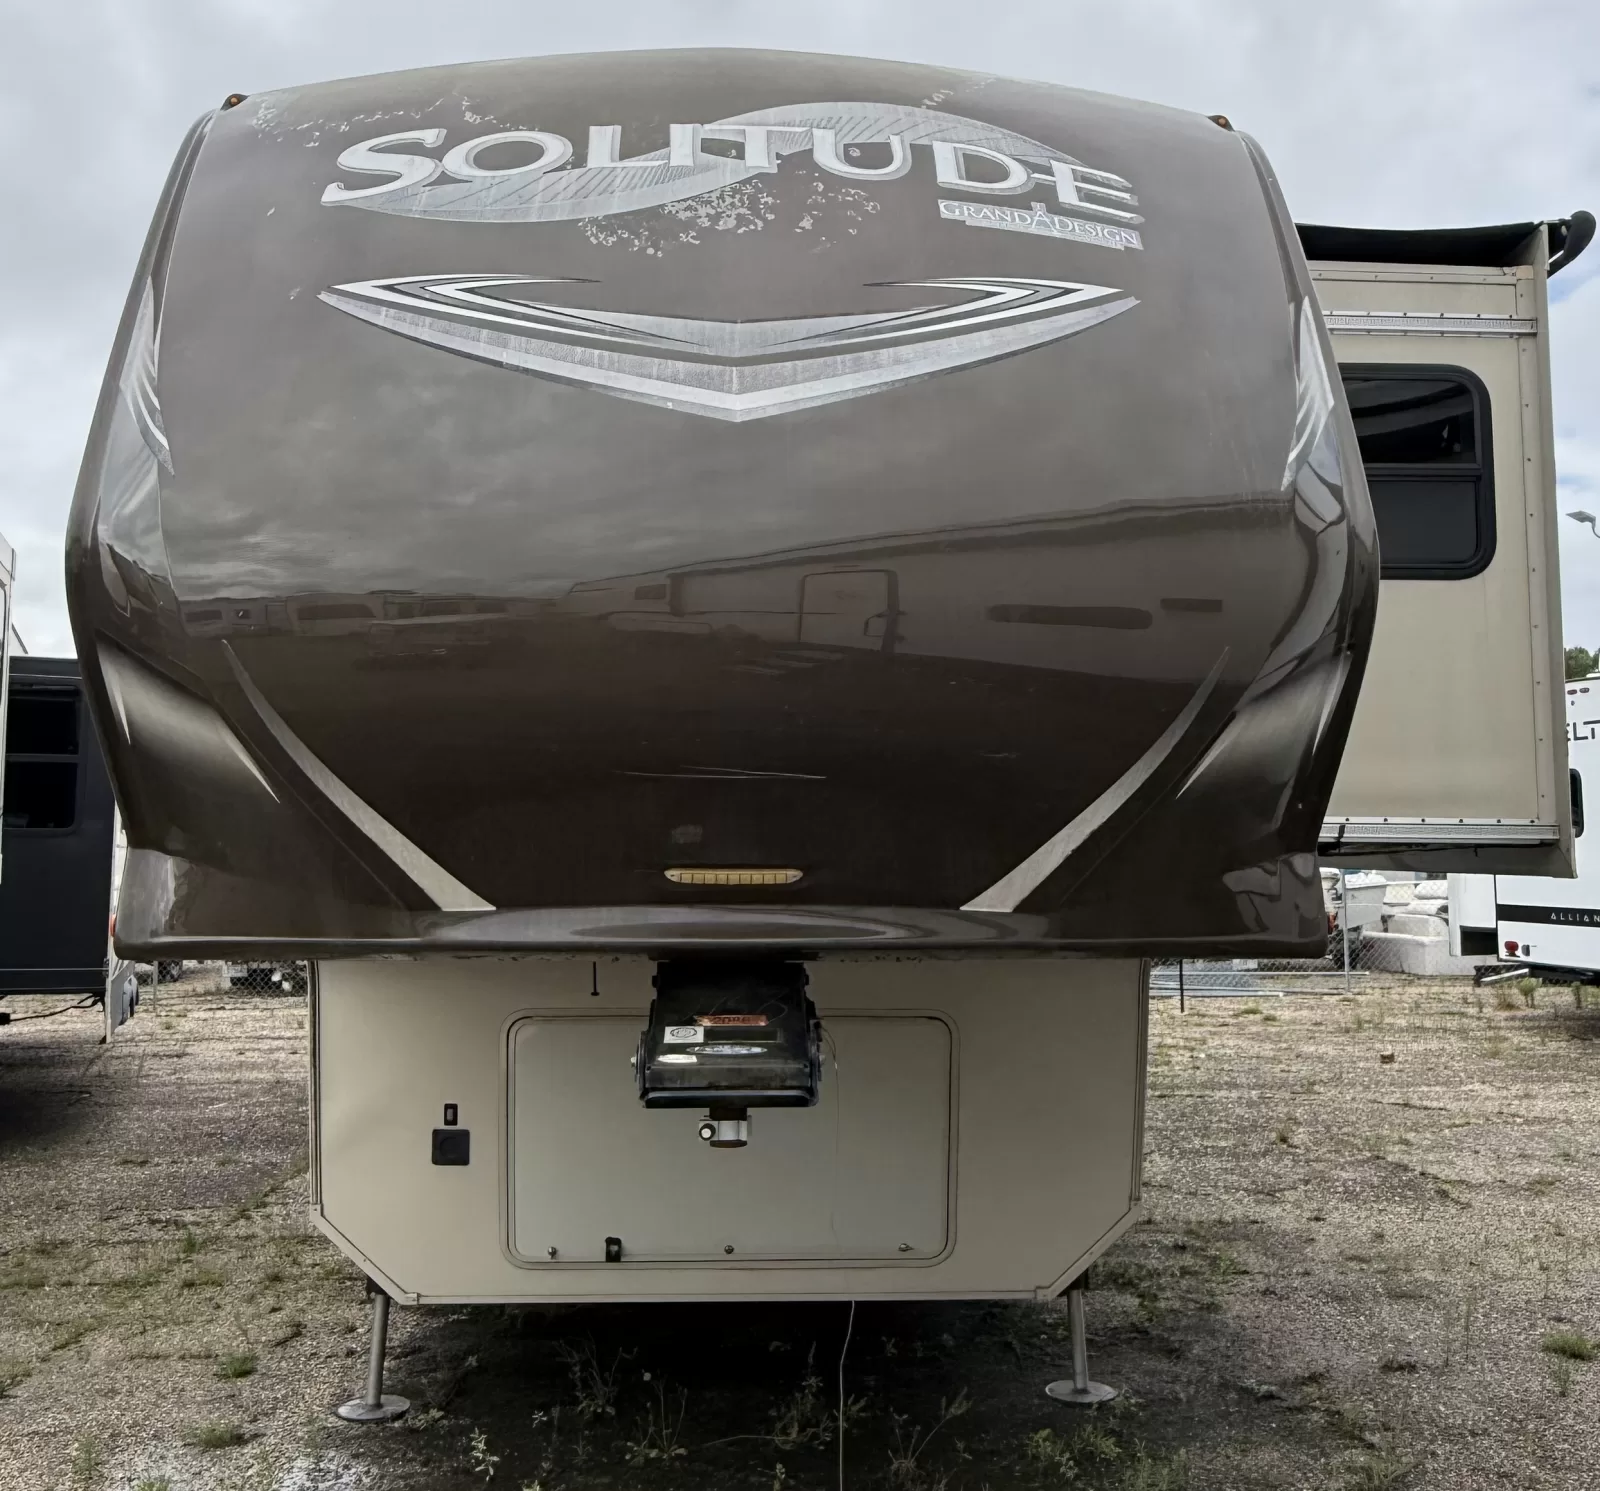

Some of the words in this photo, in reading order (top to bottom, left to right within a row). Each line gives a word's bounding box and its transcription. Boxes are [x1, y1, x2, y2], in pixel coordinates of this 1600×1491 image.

[321, 123, 1145, 224] SOLITUDE
[940, 202, 1031, 225] GRAND
[1054, 216, 1137, 245] DESIGN
[1566, 720, 1600, 741] LT
